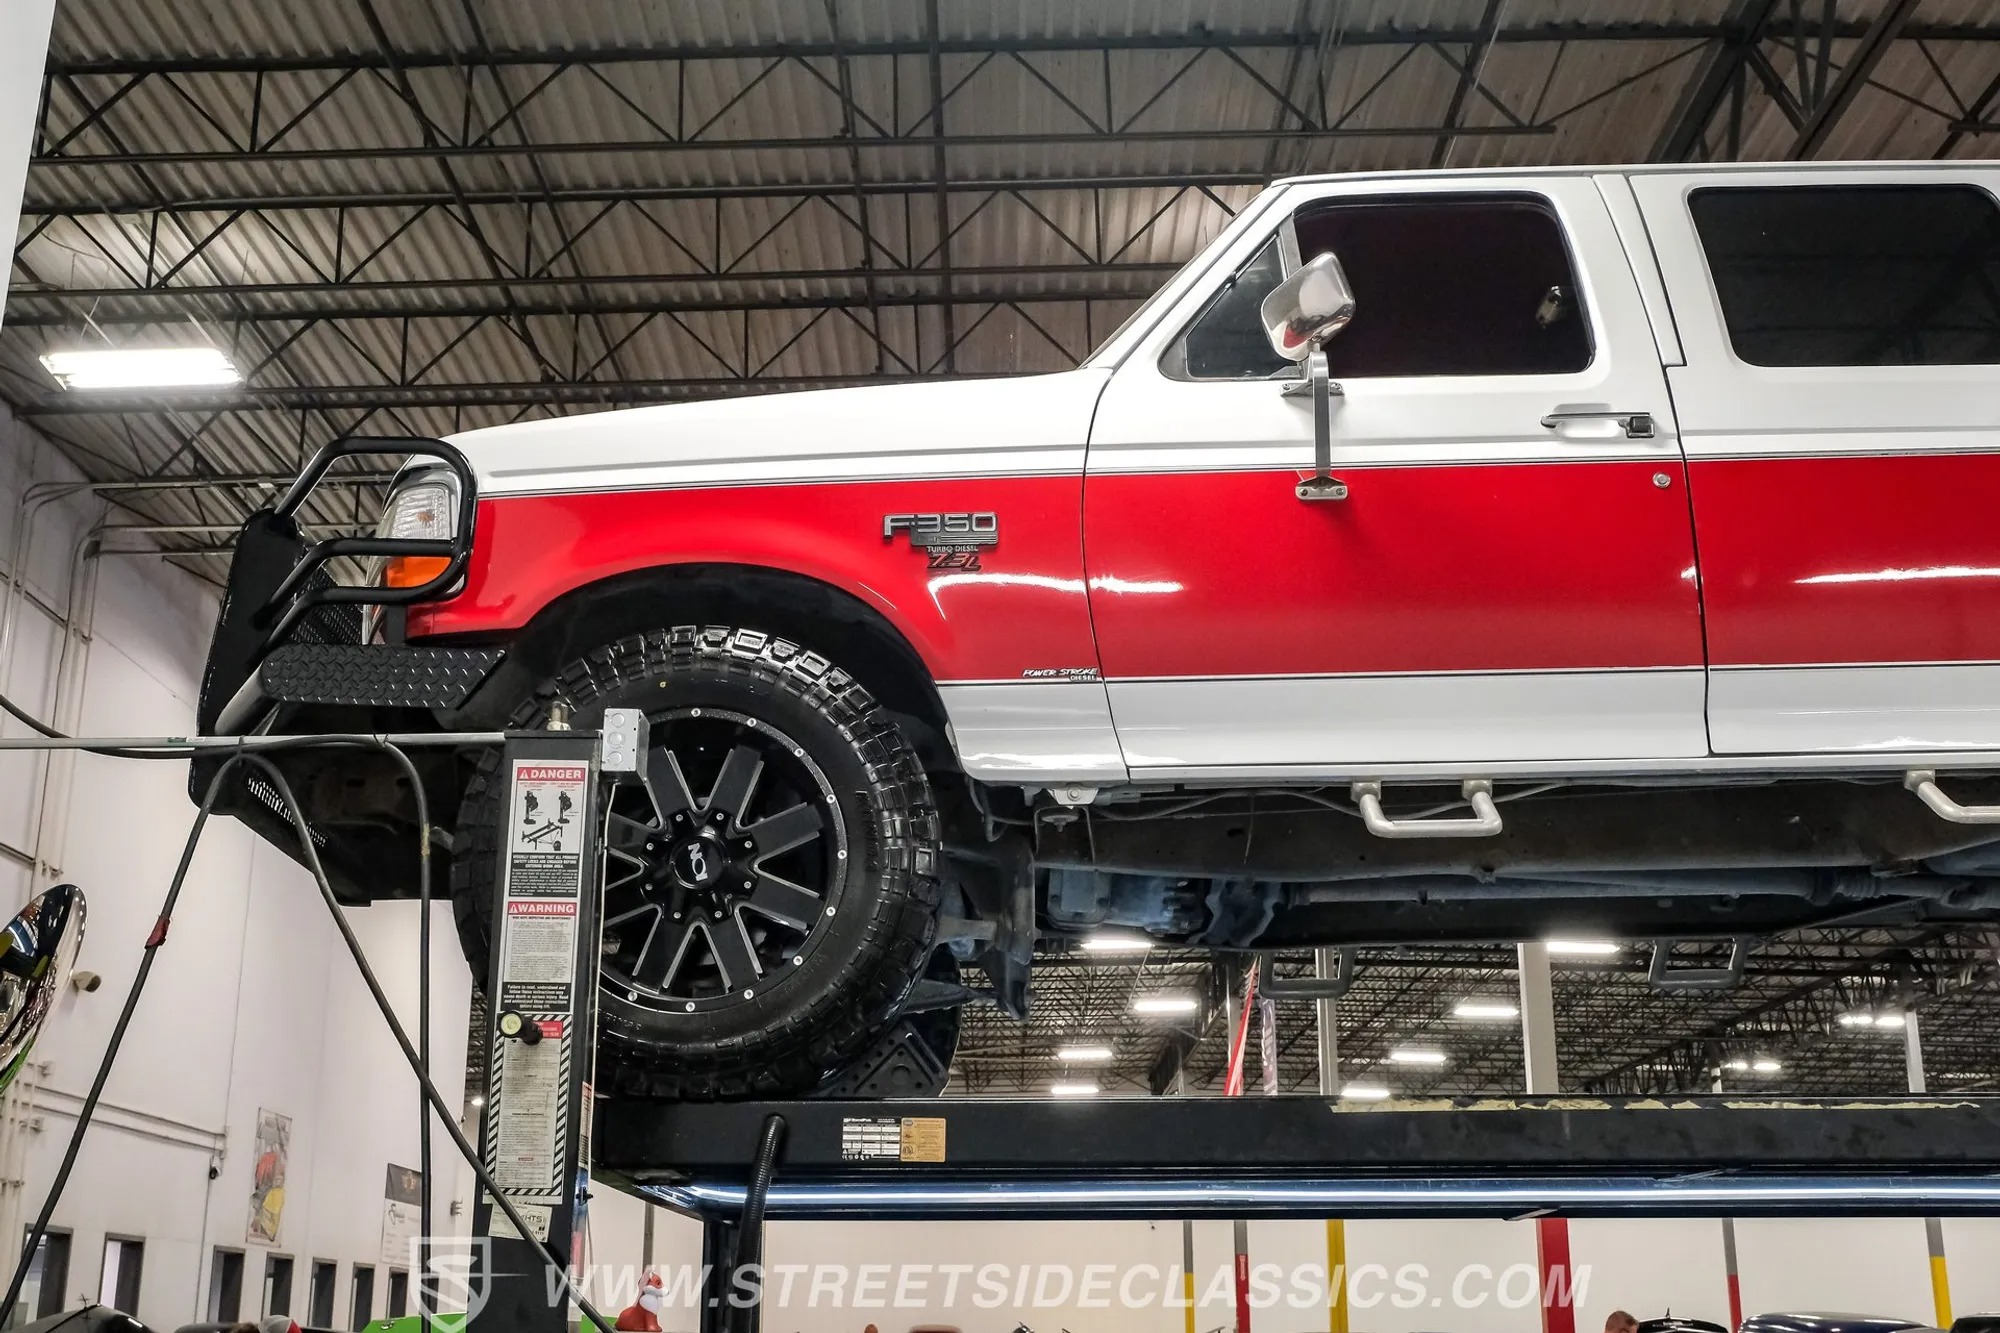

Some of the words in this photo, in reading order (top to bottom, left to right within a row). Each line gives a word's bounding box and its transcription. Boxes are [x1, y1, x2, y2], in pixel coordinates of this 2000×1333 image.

[929, 552, 980, 570] 7.3L
[1022, 668, 1057, 677] POWER
[1059, 667, 1098, 676] STROKE
[530, 769, 582, 779] DANGER
[687, 842, 708, 882] ION
[518, 904, 574, 913] WARNING
